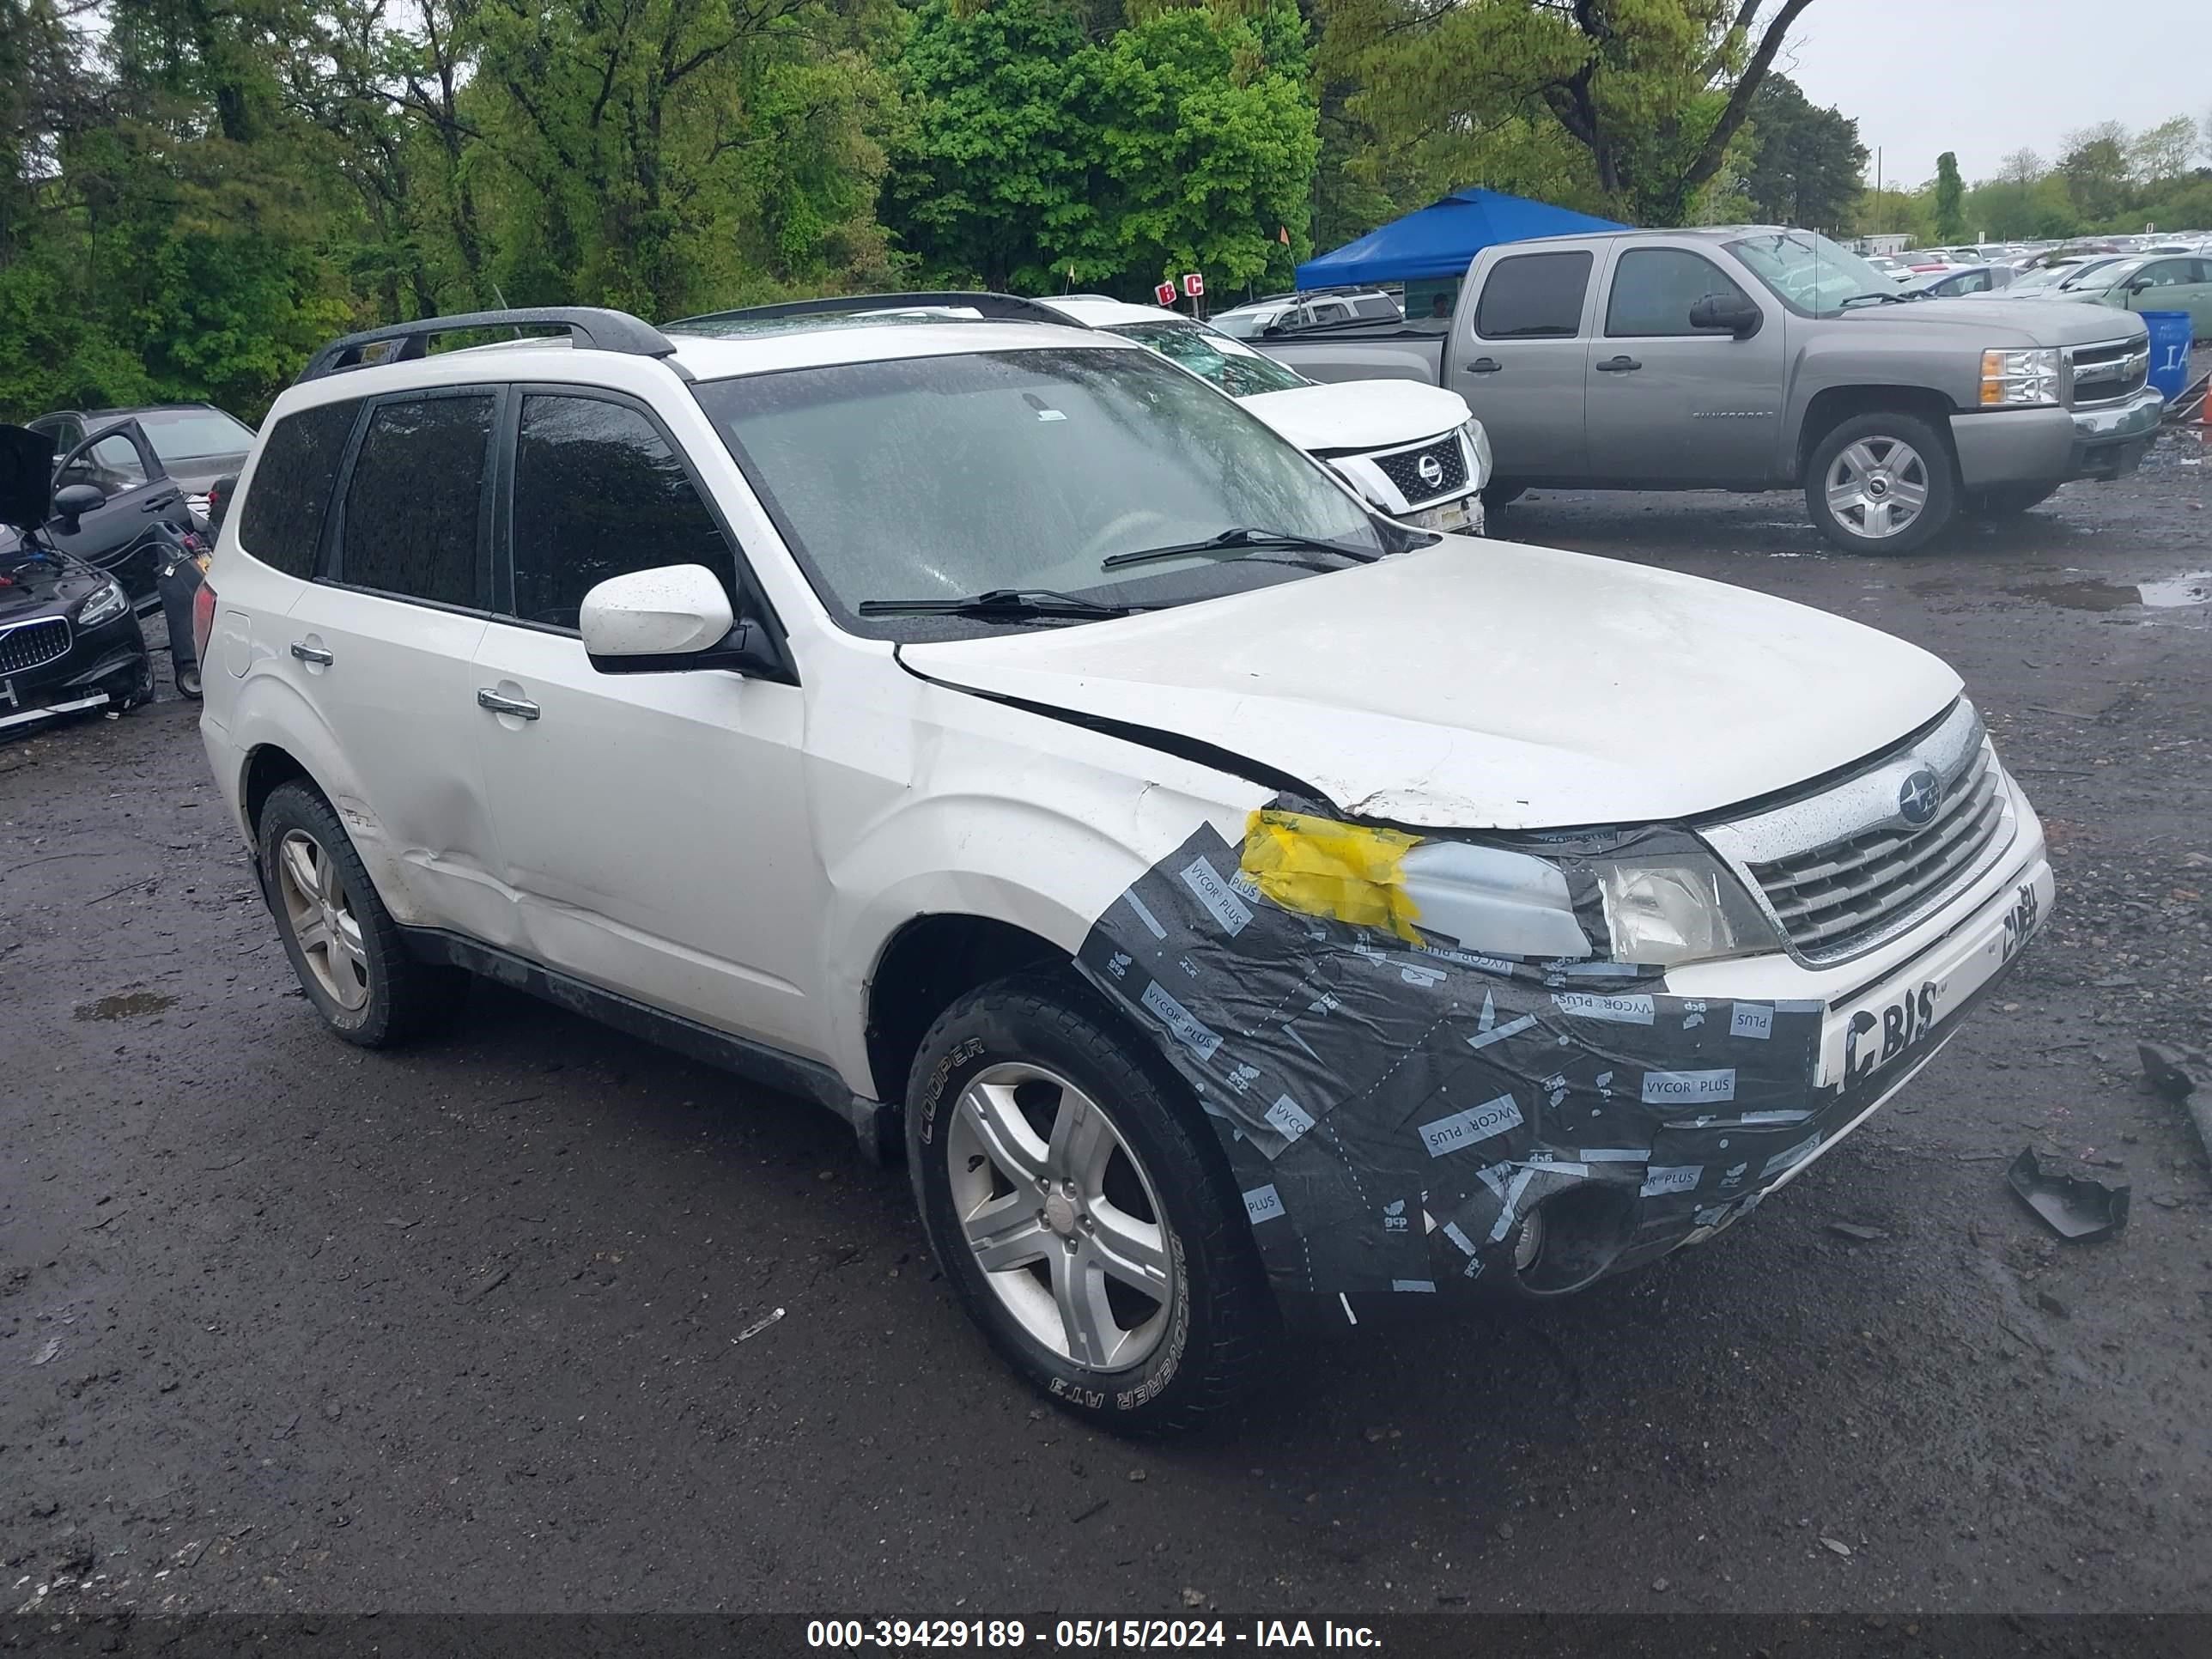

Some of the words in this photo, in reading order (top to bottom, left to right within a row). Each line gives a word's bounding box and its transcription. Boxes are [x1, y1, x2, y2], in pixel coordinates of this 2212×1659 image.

[1158, 283, 1176, 304] B
[1187, 276, 1202, 295] C
[1231, 877, 1257, 897] PLUS
[1219, 899, 1243, 926] PLUS
[1559, 994, 1594, 1007] PLUS
[1737, 1013, 1767, 1029] PLUS
[1183, 1024, 1212, 1048] PLUS
[921, 1036, 985, 1145] COOPER
[1700, 1079, 1729, 1092] PLUS
[1276, 1103, 1306, 1134] VYCO
[1429, 1127, 1463, 1147] PLUS
[1664, 1172, 1694, 1184] PLUS
[1248, 1195, 1275, 1213] PLUS
[1117, 1230, 1190, 1410] DISCOVERER
